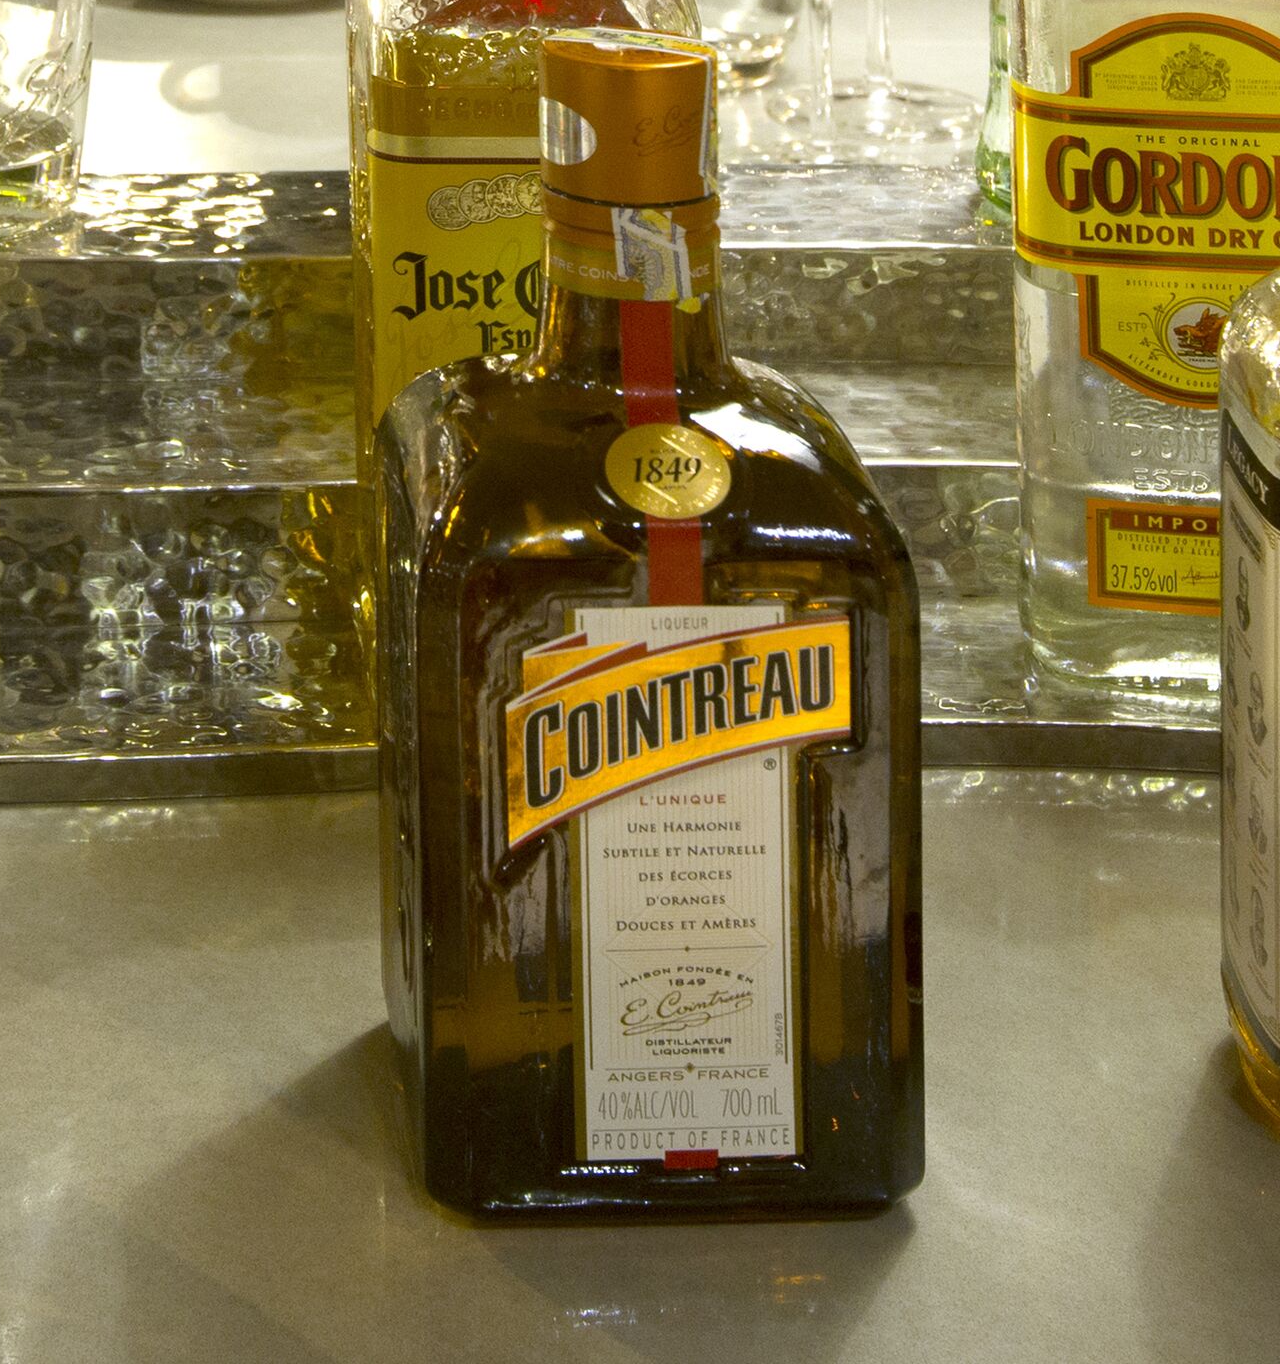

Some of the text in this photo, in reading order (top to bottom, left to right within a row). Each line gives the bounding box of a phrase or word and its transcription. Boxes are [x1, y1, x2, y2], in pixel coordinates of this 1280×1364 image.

[1135, 135, 1261, 148] THE ORIGINAL
[1079, 220, 1195, 247] LONDON
[1209, 227, 1265, 249] DRY
[392, 251, 506, 321] Jose
[633, 457, 703, 484] 1849
[1117, 532, 1211, 548] DISTILLED TO THE
[1131, 543, 1166, 554] RECIPE
[651, 617, 709, 631] LIQUEUR
[524, 644, 835, 809] COINTREAU
[639, 794, 728, 806] L'UNIQUE
[663, 821, 742, 833] HARMONIE
[603, 845, 767, 859] SUBTILE ET NATURELLE
[638, 869, 733, 882] DES ÉCORCES
[646, 895, 727, 907] D'ORANGES
[616, 920, 674, 932] DOUCES
[681, 920, 697, 930] ET
[619, 965, 755, 988] MAISON FONDÉE EN
[668, 977, 708, 986] 1849
[645, 1037, 733, 1047] DISTILLATEUR
[652, 1047, 726, 1056] LIQUORISTE
[607, 1068, 770, 1082] ANGERS FRANCE
[719, 1088, 753, 1117] 700
[757, 1087, 784, 1116] mL
[592, 1127, 791, 1151] PRODUCT OF FRANCE
